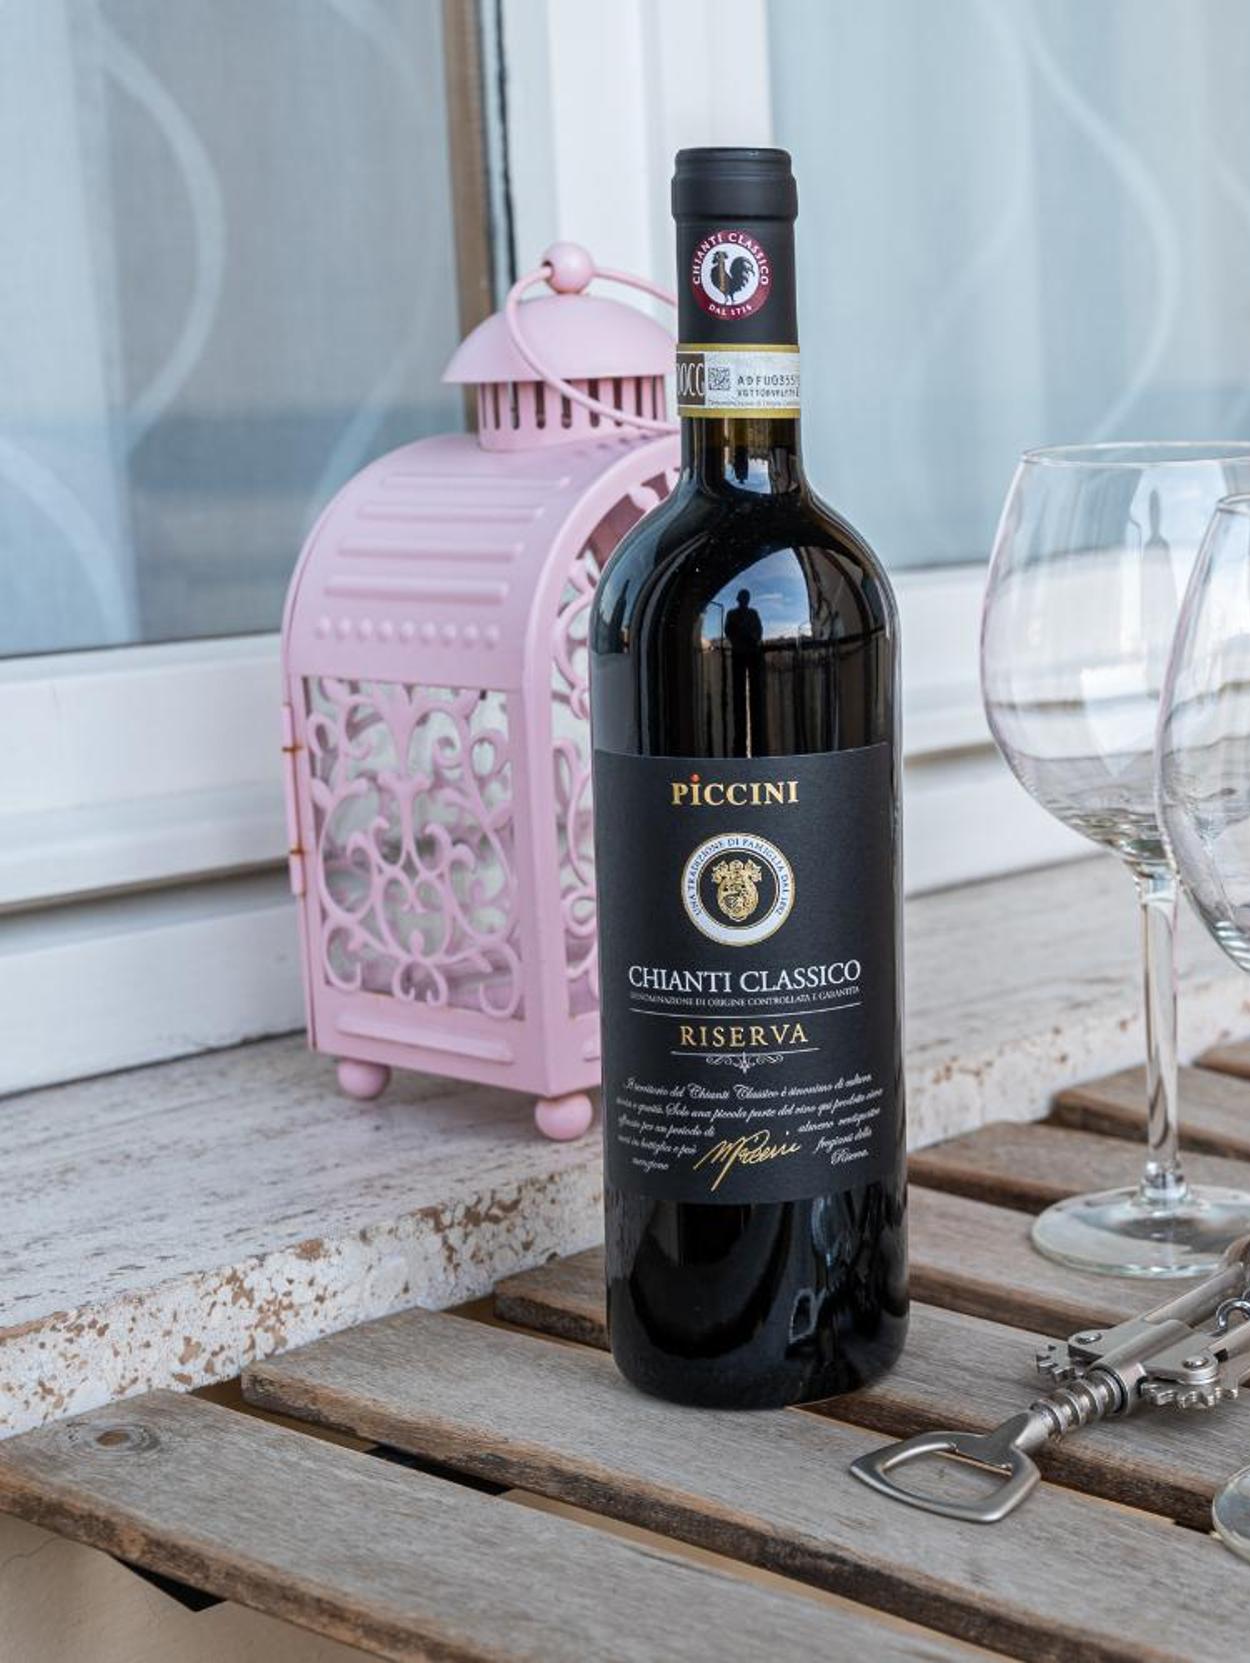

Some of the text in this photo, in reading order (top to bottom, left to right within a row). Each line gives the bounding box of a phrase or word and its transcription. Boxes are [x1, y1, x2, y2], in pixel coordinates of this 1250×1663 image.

[692, 232, 769, 286] CHIANTI CLASSICO
[708, 304, 726, 316] DAL
[727, 839, 740, 848] DI
[687, 841, 725, 891] TRADIZIONE
[742, 839, 786, 872] FAMIGLIA
[687, 894, 701, 916] UNA
[628, 959, 861, 993] CHIANTI CLASSICO
[707, 997, 746, 1007] ORIGINE
[680, 1023, 809, 1047] RISERVA
[669, 1086, 686, 1098] del
[687, 1083, 730, 1099] Chianti
[732, 1084, 779, 1100] Classico
[833, 1077, 845, 1089] di
[665, 1102, 690, 1117] Solo
[690, 1110, 712, 1118] una
[710, 1107, 748, 1123] piccola
[746, 1108, 777, 1123] parte
[777, 1104, 796, 1117] del
[795, 1104, 817, 1115] vino
[665, 1123, 702, 1139] periodo
[703, 1126, 716, 1137] di
